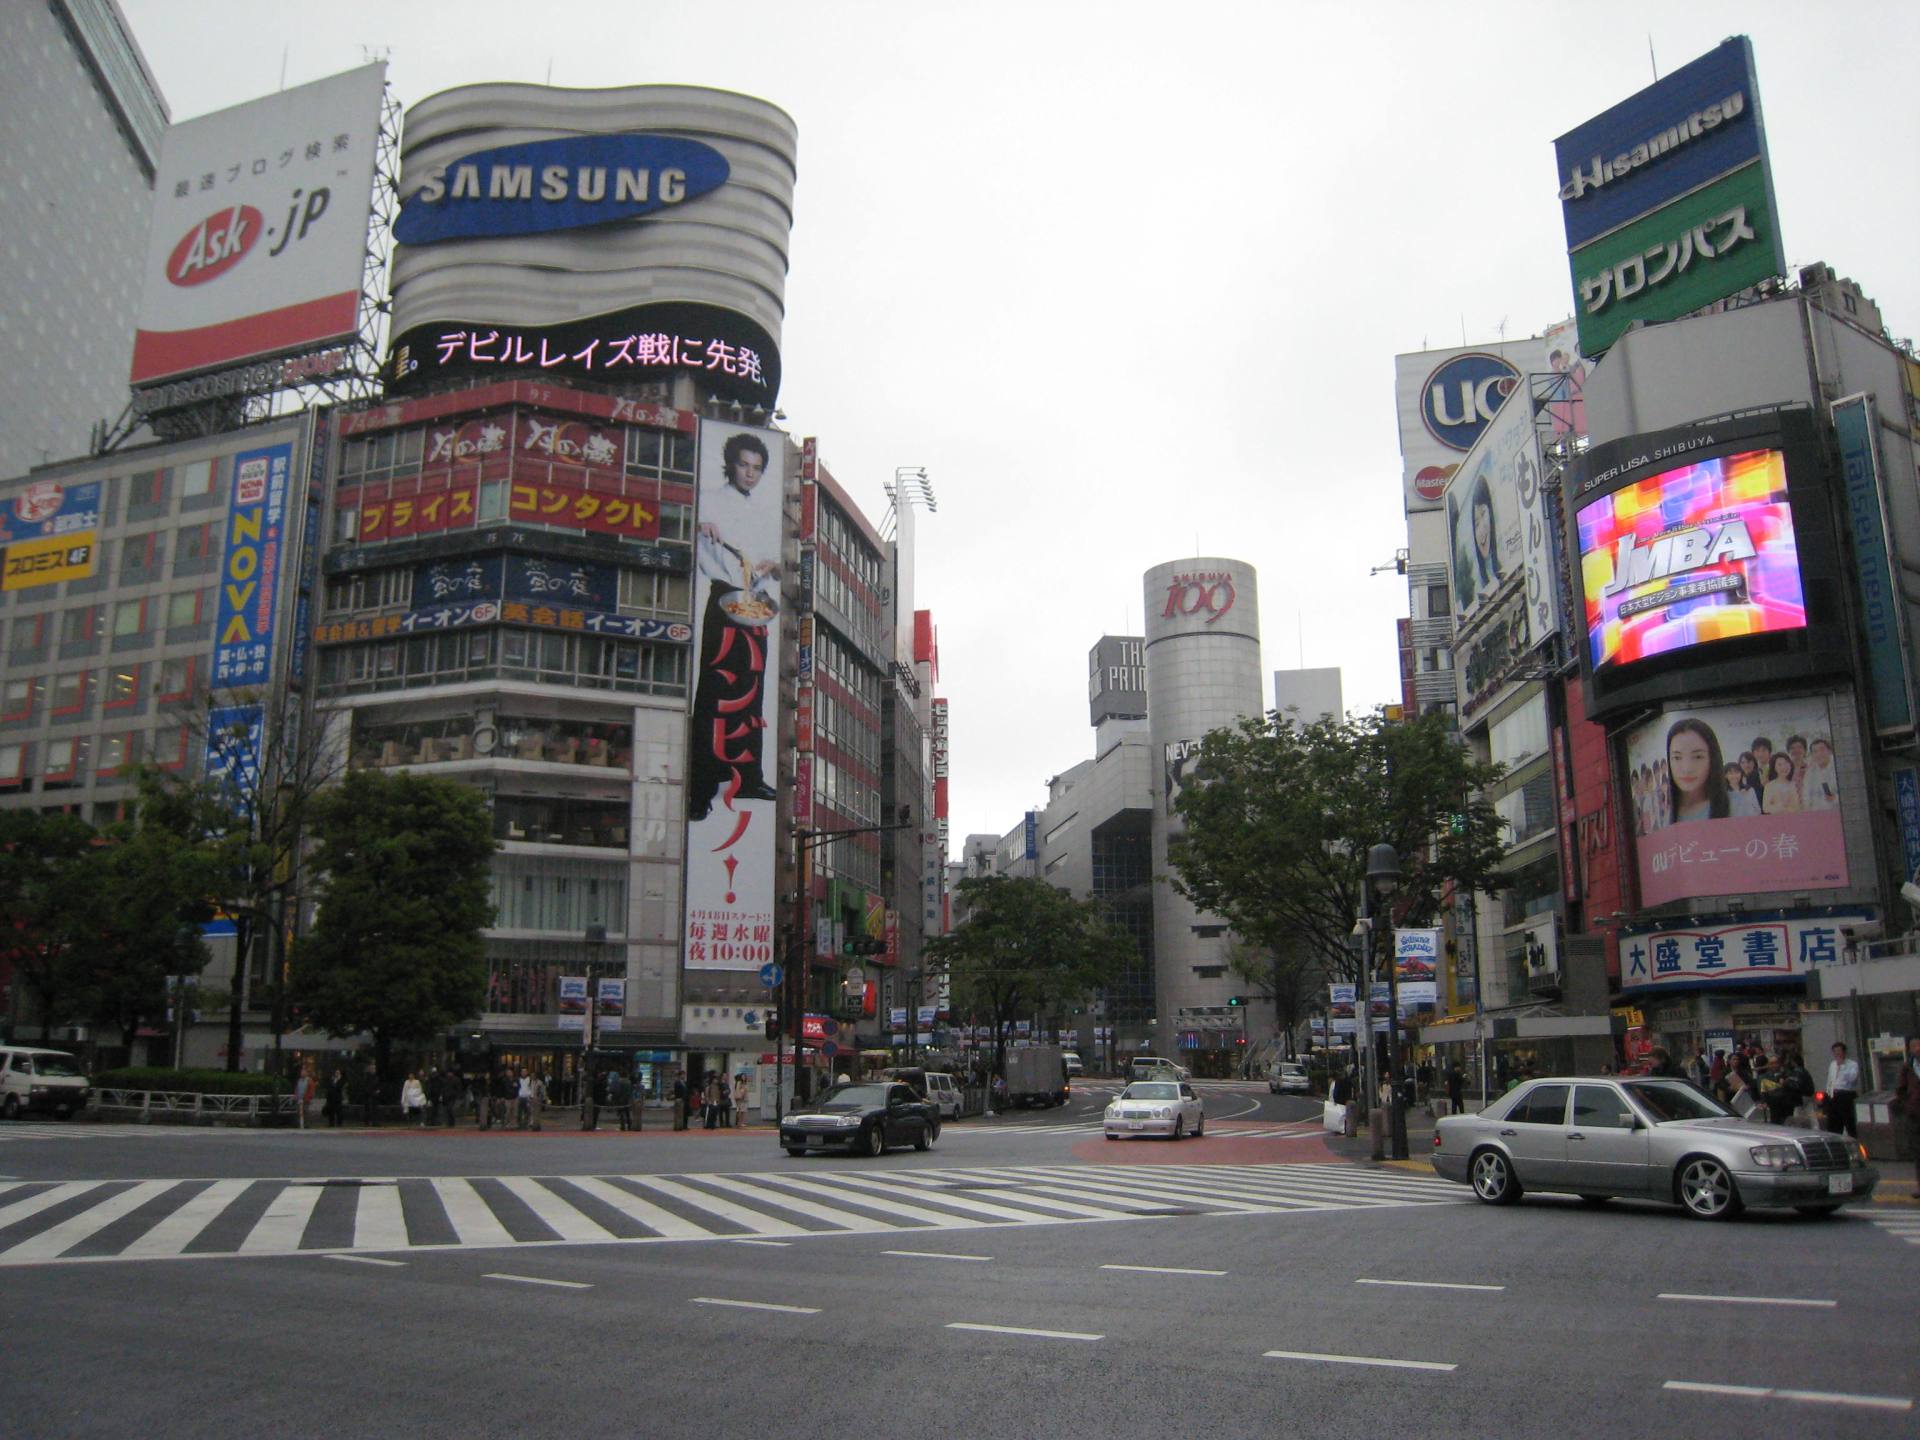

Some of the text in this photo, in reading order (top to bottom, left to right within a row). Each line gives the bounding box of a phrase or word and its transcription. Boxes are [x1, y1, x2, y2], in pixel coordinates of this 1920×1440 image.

[1558, 91, 1744, 201] Hisamitsu
[419, 165, 687, 204] SAMSUNG
[1579, 204, 1755, 314] サロンパス
[1584, 434, 1715, 492] SUPER LISA SHIBUYA
[363, 490, 473, 533] プライス
[511, 485, 654, 528] コンタクト
[8, 549, 63, 576] プロミス
[221, 507, 263, 644] NOVA
[1172, 571, 1234, 583] SHIBUYA
[402, 607, 470, 632] イーオン
[474, 605, 493, 620] 6F
[503, 602, 690, 639] 英会話 イーオン 6F
[1161, 581, 1236, 624] 109
[690, 922, 771, 943] 毎週水曜
[1629, 927, 1838, 978] 大盛堂書店
